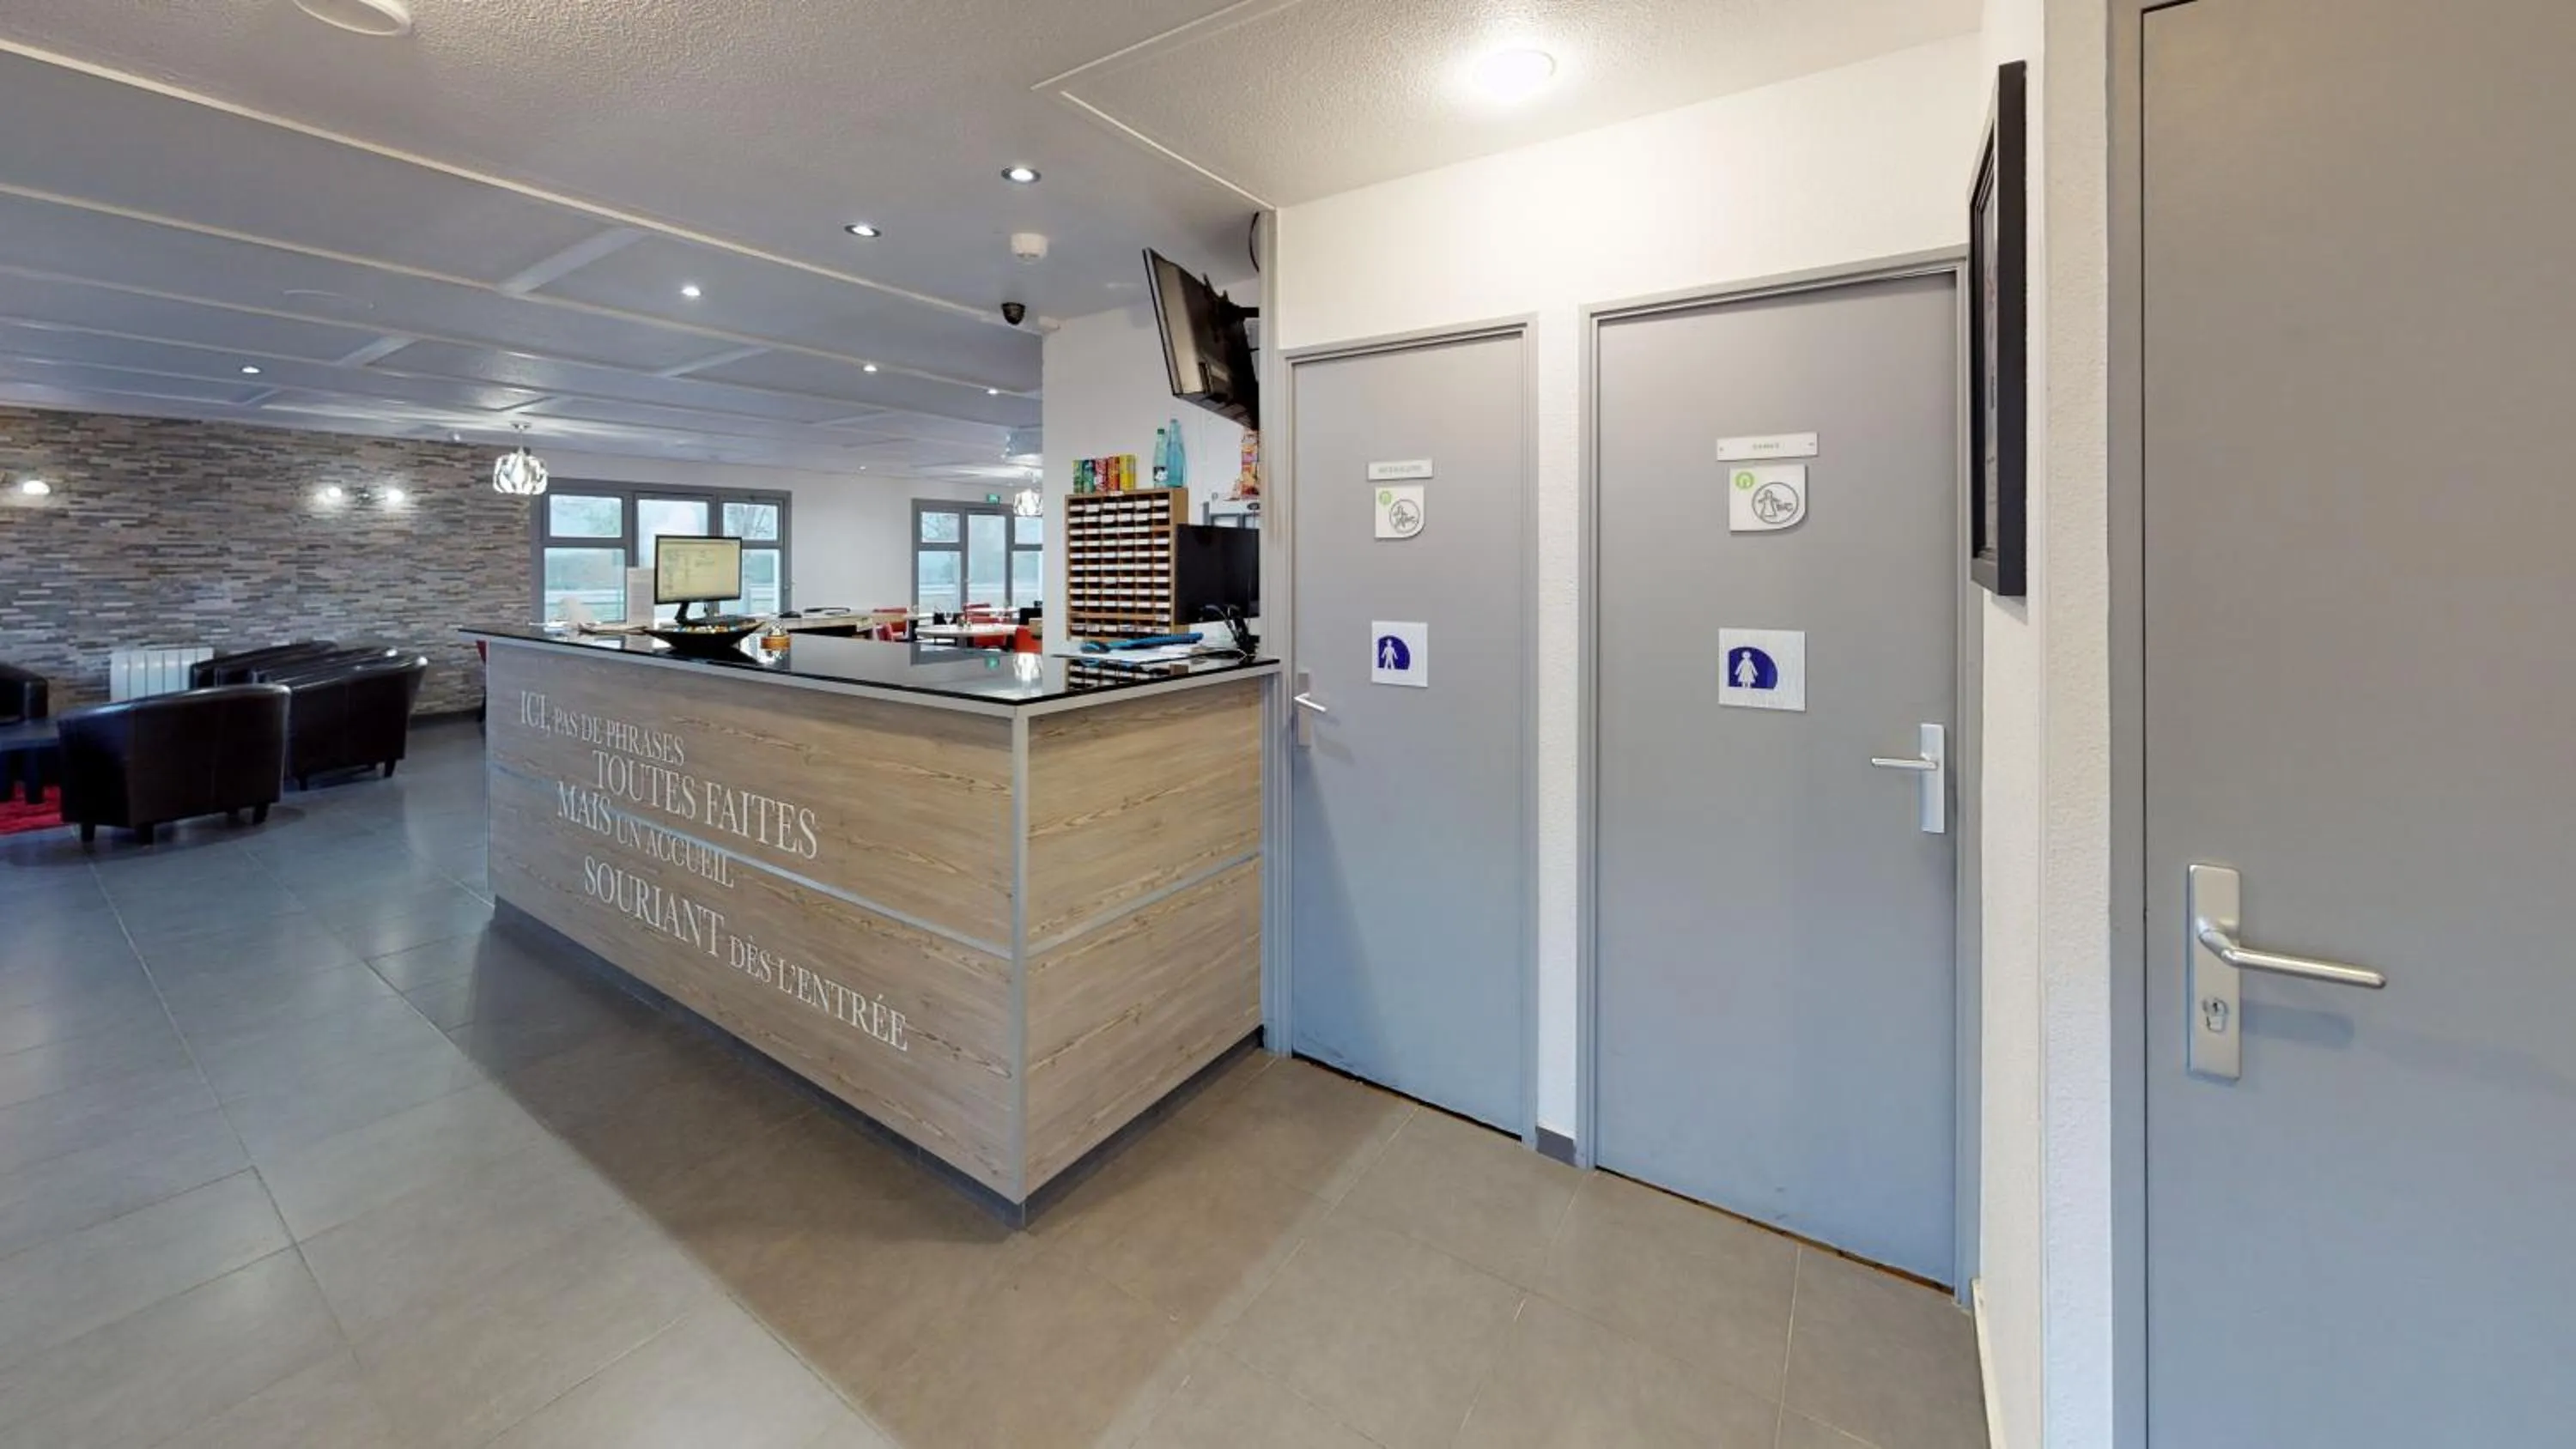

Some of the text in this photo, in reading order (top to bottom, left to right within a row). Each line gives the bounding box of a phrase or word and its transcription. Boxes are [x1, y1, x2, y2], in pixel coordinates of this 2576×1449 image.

[521, 690, 685, 766] ICI, PAS DE PHRASES
[558, 780, 734, 888] MAIS UN ACCUEIL
[592, 750, 817, 859] TOUTES FAITES
[585, 856, 908, 1052] SOURIANT DÈS L'ENTRÉE
